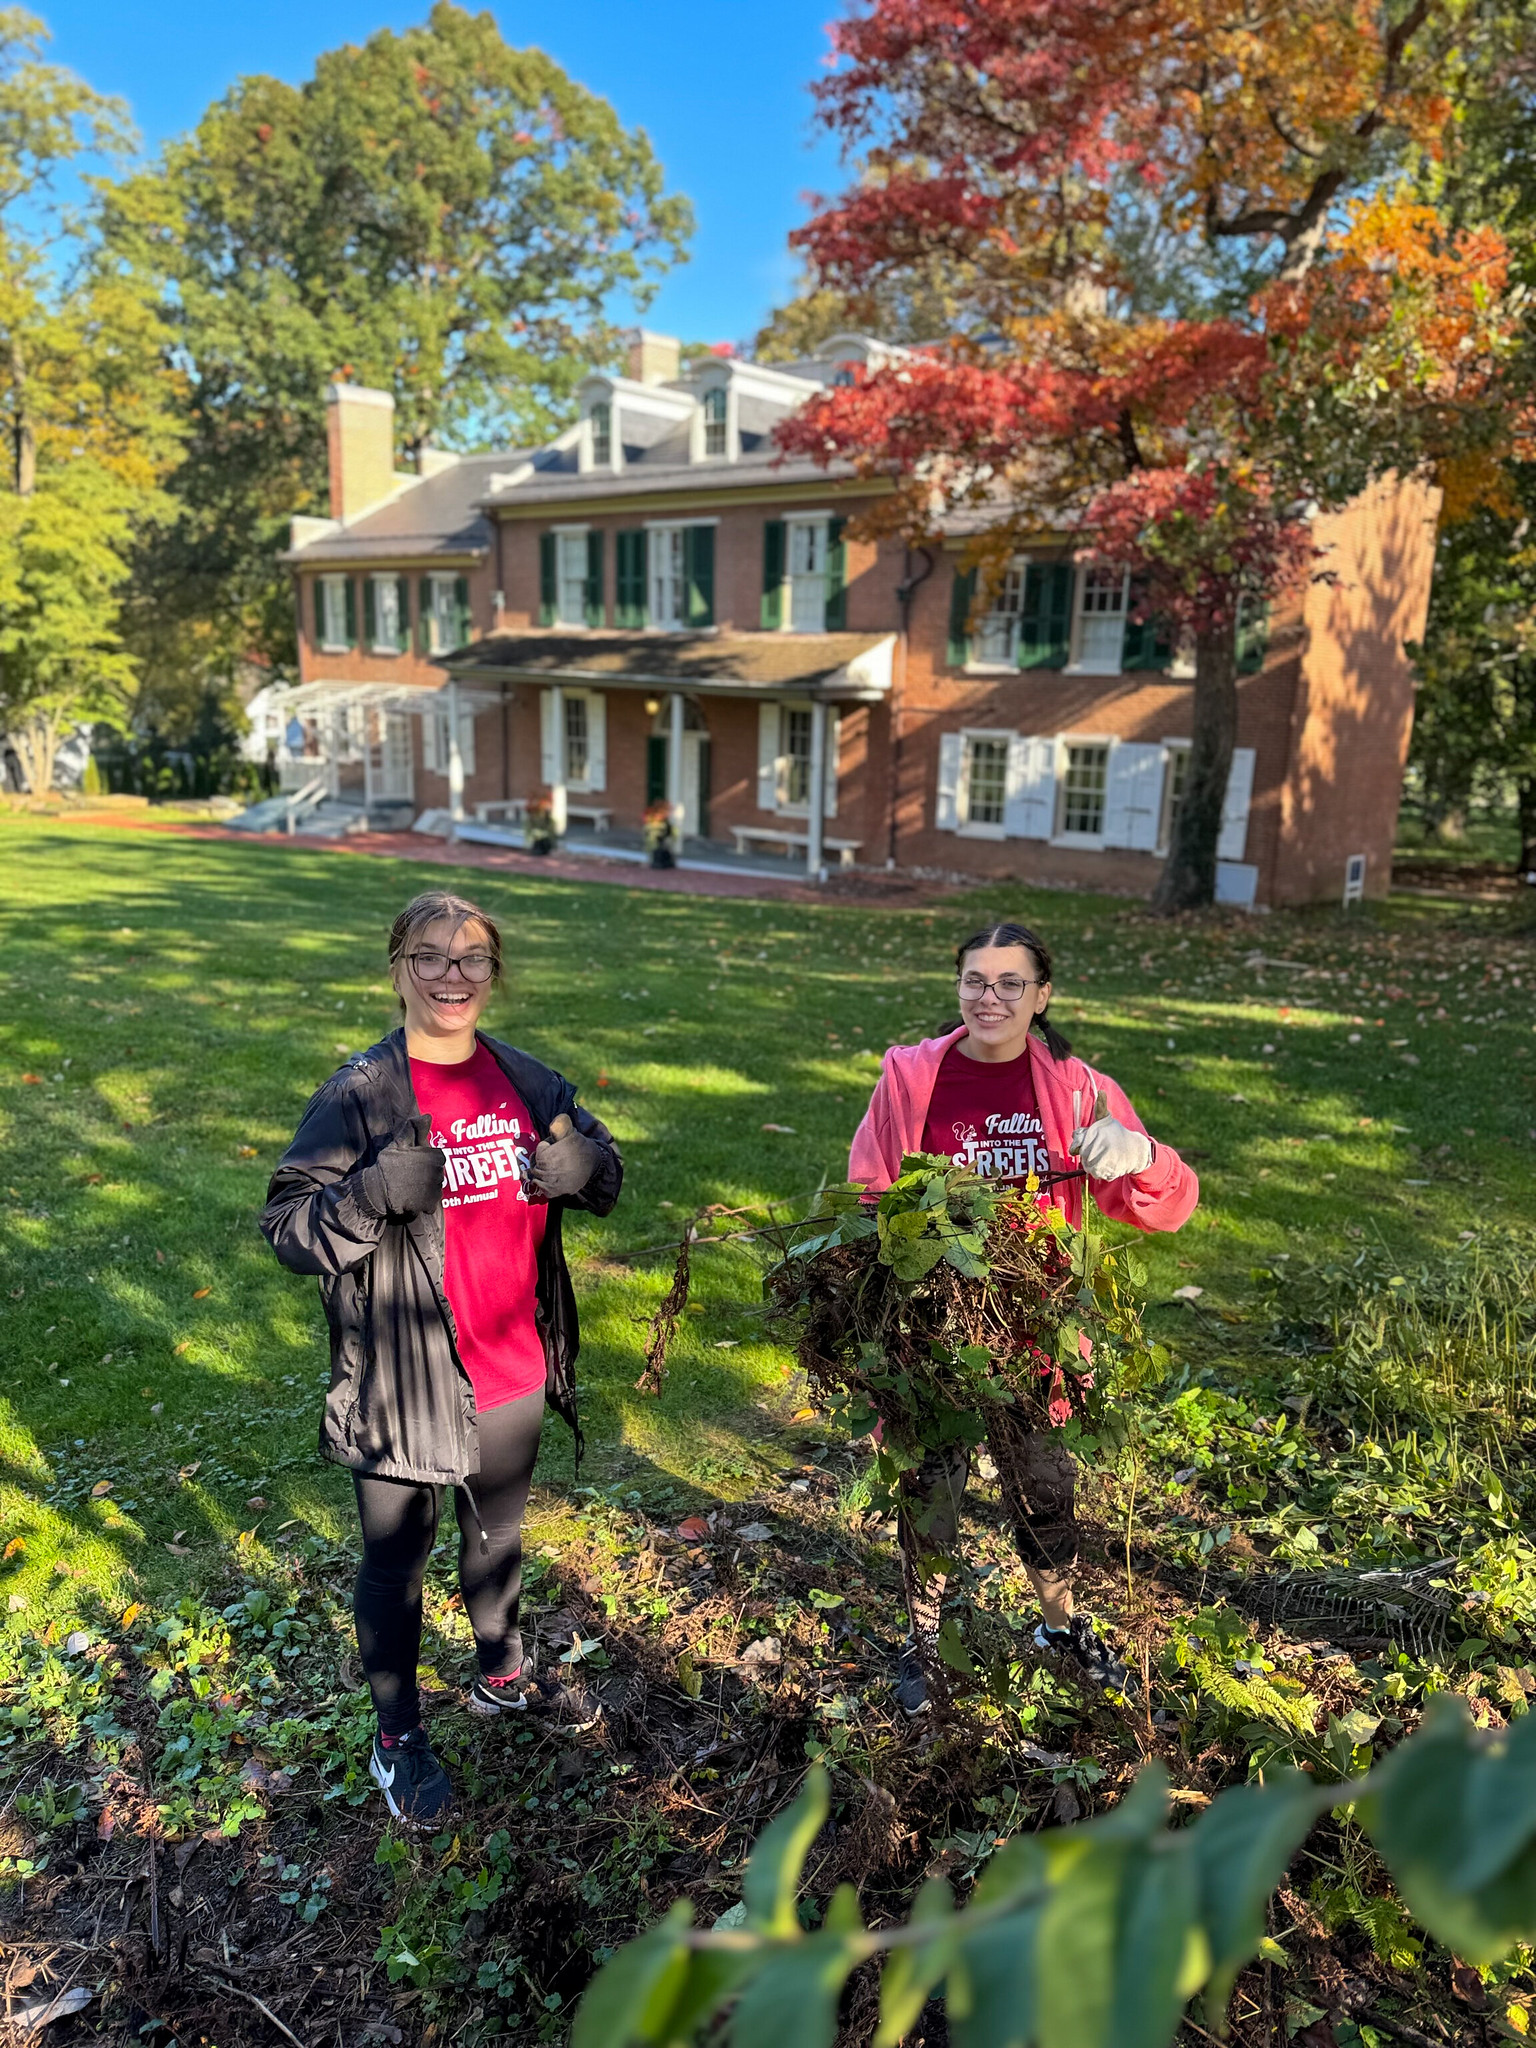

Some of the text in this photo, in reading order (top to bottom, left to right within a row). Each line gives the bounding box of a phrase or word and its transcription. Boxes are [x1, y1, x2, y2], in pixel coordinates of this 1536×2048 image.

[451, 1113, 520, 1142] Falling
[453, 1141, 497, 1155] INTO THE
[980, 1139, 1022, 1148] INTO THE
[442, 1138, 531, 1192] TREETS
[463, 1189, 499, 1205] Annual
